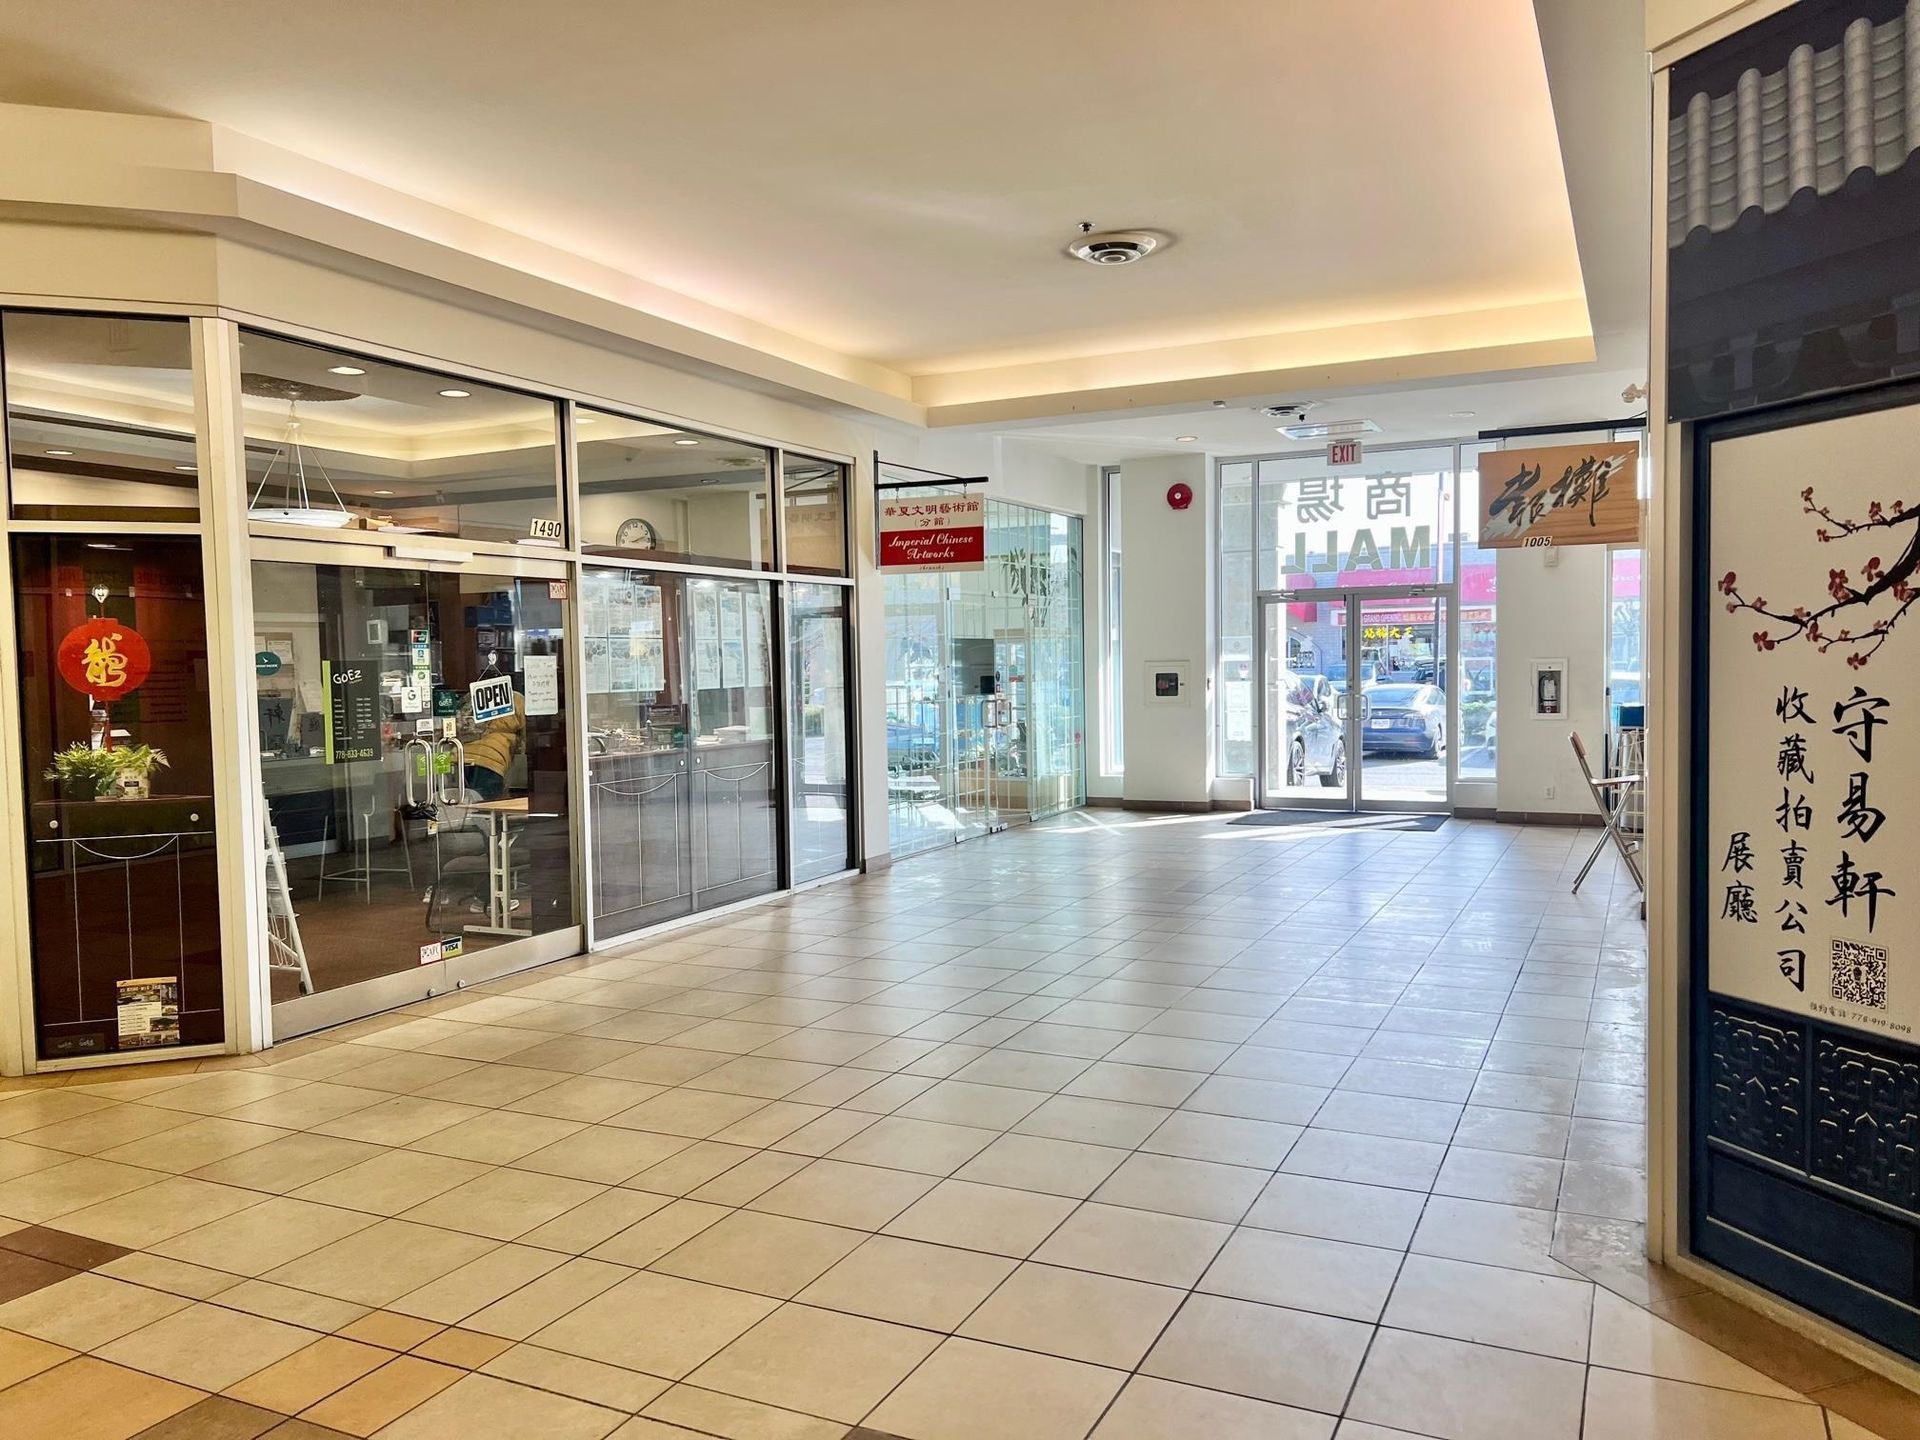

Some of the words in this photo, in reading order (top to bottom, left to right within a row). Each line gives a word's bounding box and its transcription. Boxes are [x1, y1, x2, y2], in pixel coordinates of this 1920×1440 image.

[1332, 444, 1357, 463] EXIT
[884, 501, 980, 517] 華夏文明藝術館
[533, 520, 562, 538] 1490
[889, 534, 935, 550] Imperial
[936, 533, 973, 545] Chinese
[1524, 536, 1551, 548] 1005
[907, 547, 955, 560] Artworks
[475, 682, 510, 711] OPEN
[1825, 686, 1896, 934] 守易軒
[1775, 685, 1817, 993] 收藏拍賣公司
[1721, 831, 1758, 924] 展廳
[444, 942, 459, 952] VISA
